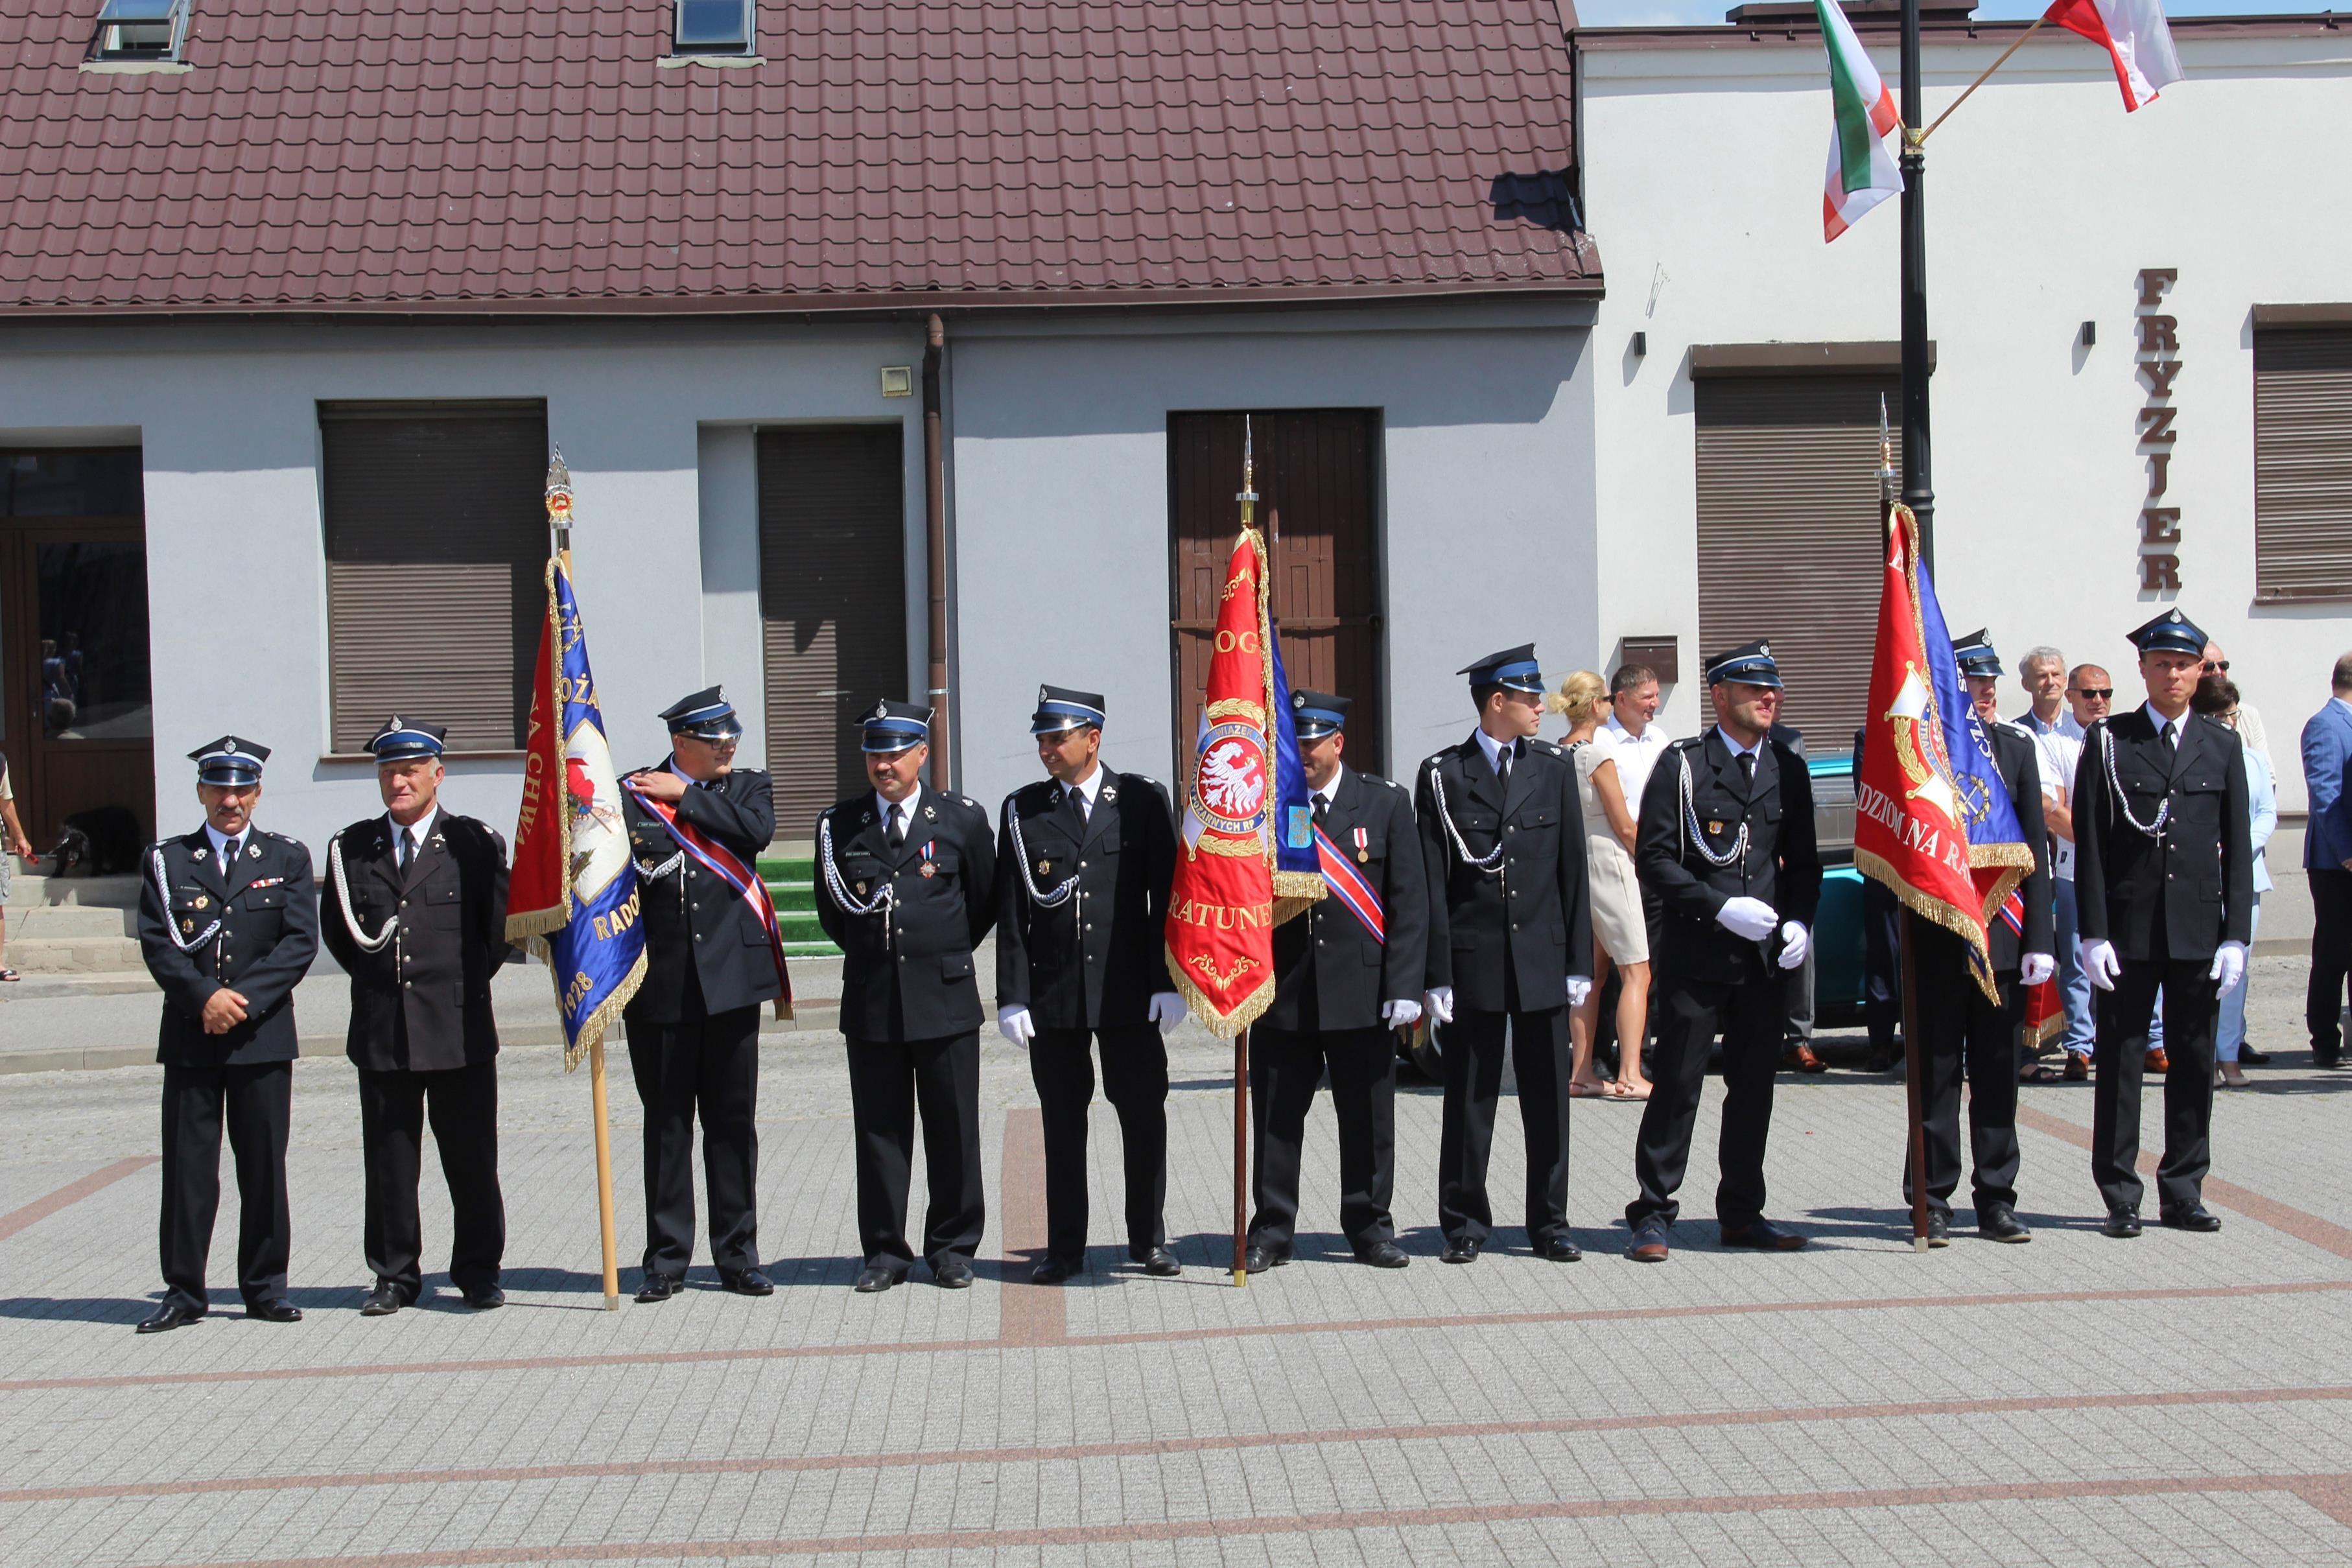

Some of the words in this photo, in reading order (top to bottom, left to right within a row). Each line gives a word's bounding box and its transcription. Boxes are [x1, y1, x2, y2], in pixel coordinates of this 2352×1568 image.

[2139, 268, 2182, 589] FRYZJER
[514, 752, 543, 863] CHWA
[1243, 819, 1255, 830] RP
[1903, 817, 1940, 858] NA
[563, 971, 594, 1019] 1928
